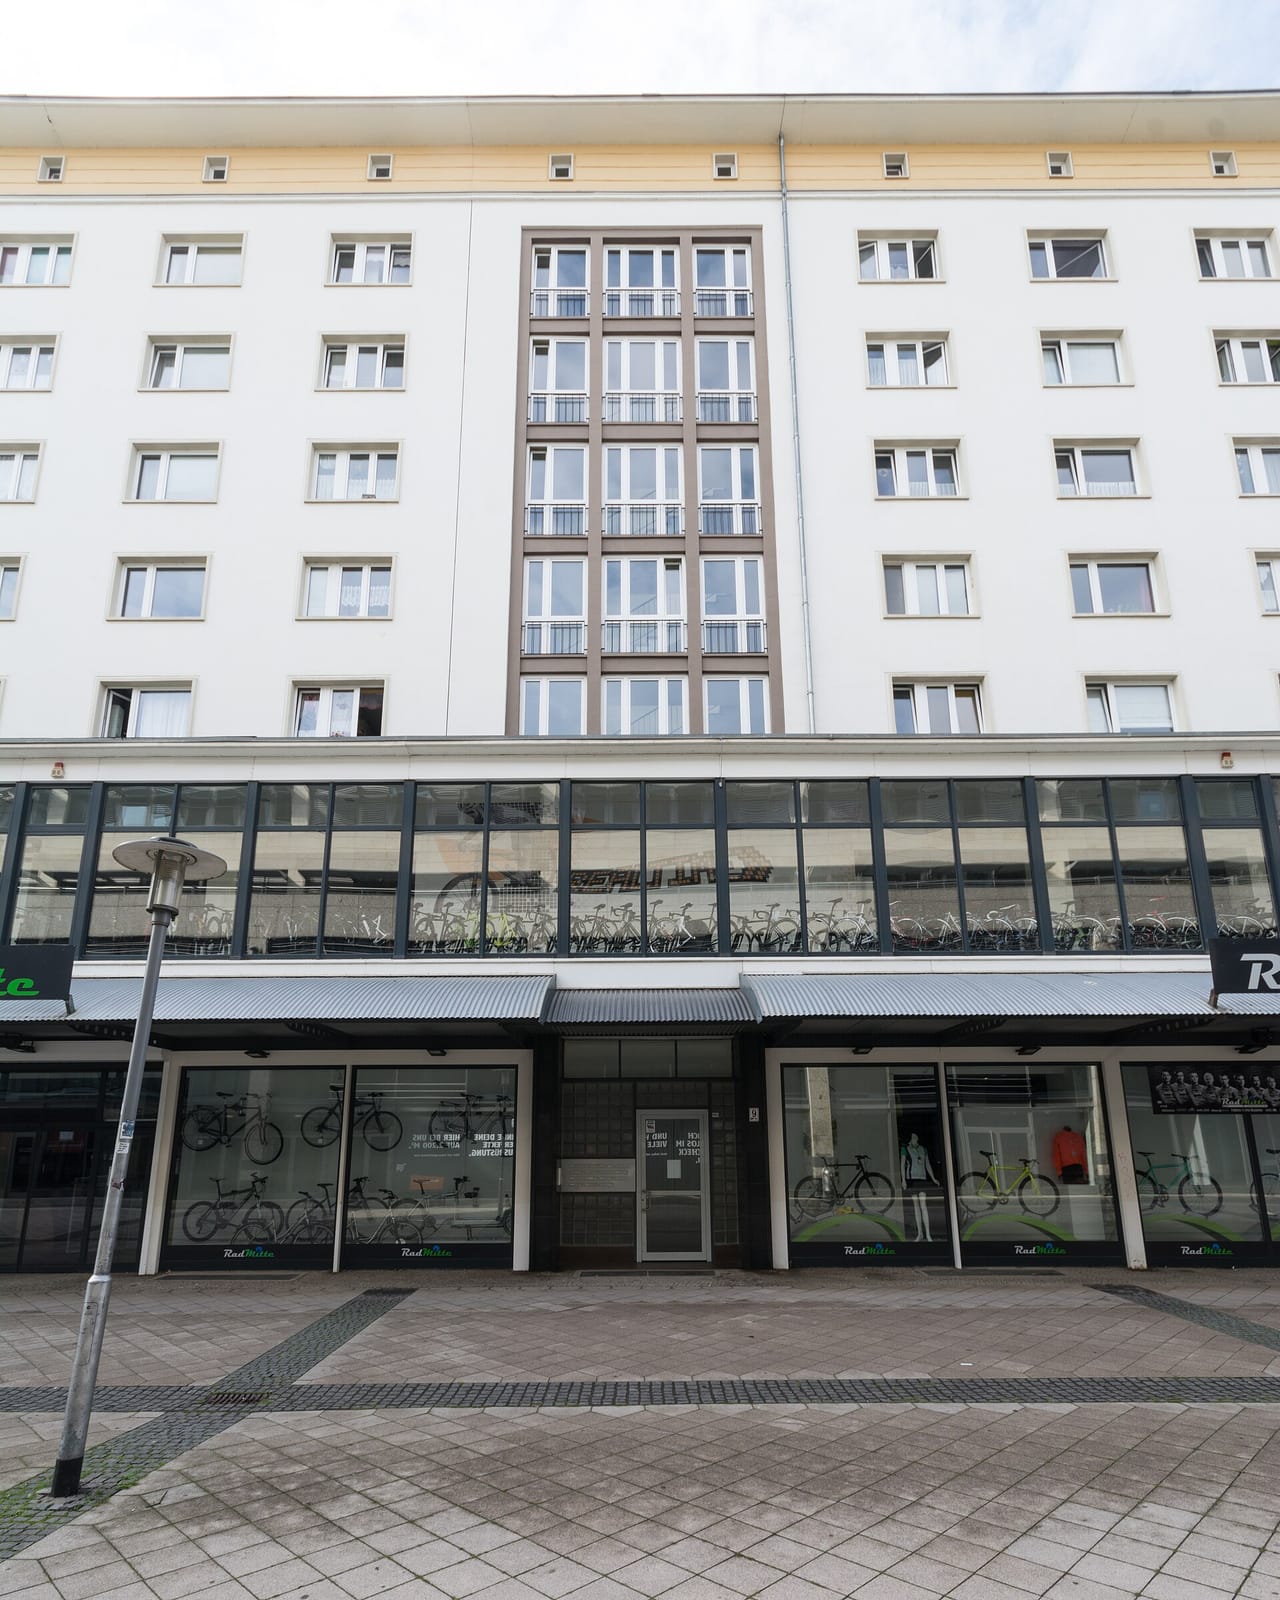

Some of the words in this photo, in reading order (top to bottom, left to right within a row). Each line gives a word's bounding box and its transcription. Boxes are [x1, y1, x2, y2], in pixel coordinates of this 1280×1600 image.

[1240, 953, 1280, 990] R
[751, 1109, 757, 1117] 9
[224, 1247, 275, 1258] RadMitte
[401, 1246, 452, 1257] RadMitte
[844, 1244, 897, 1255] RadMitte
[1014, 1244, 1067, 1255] RadMitte
[1180, 1244, 1233, 1255] RadMitte
